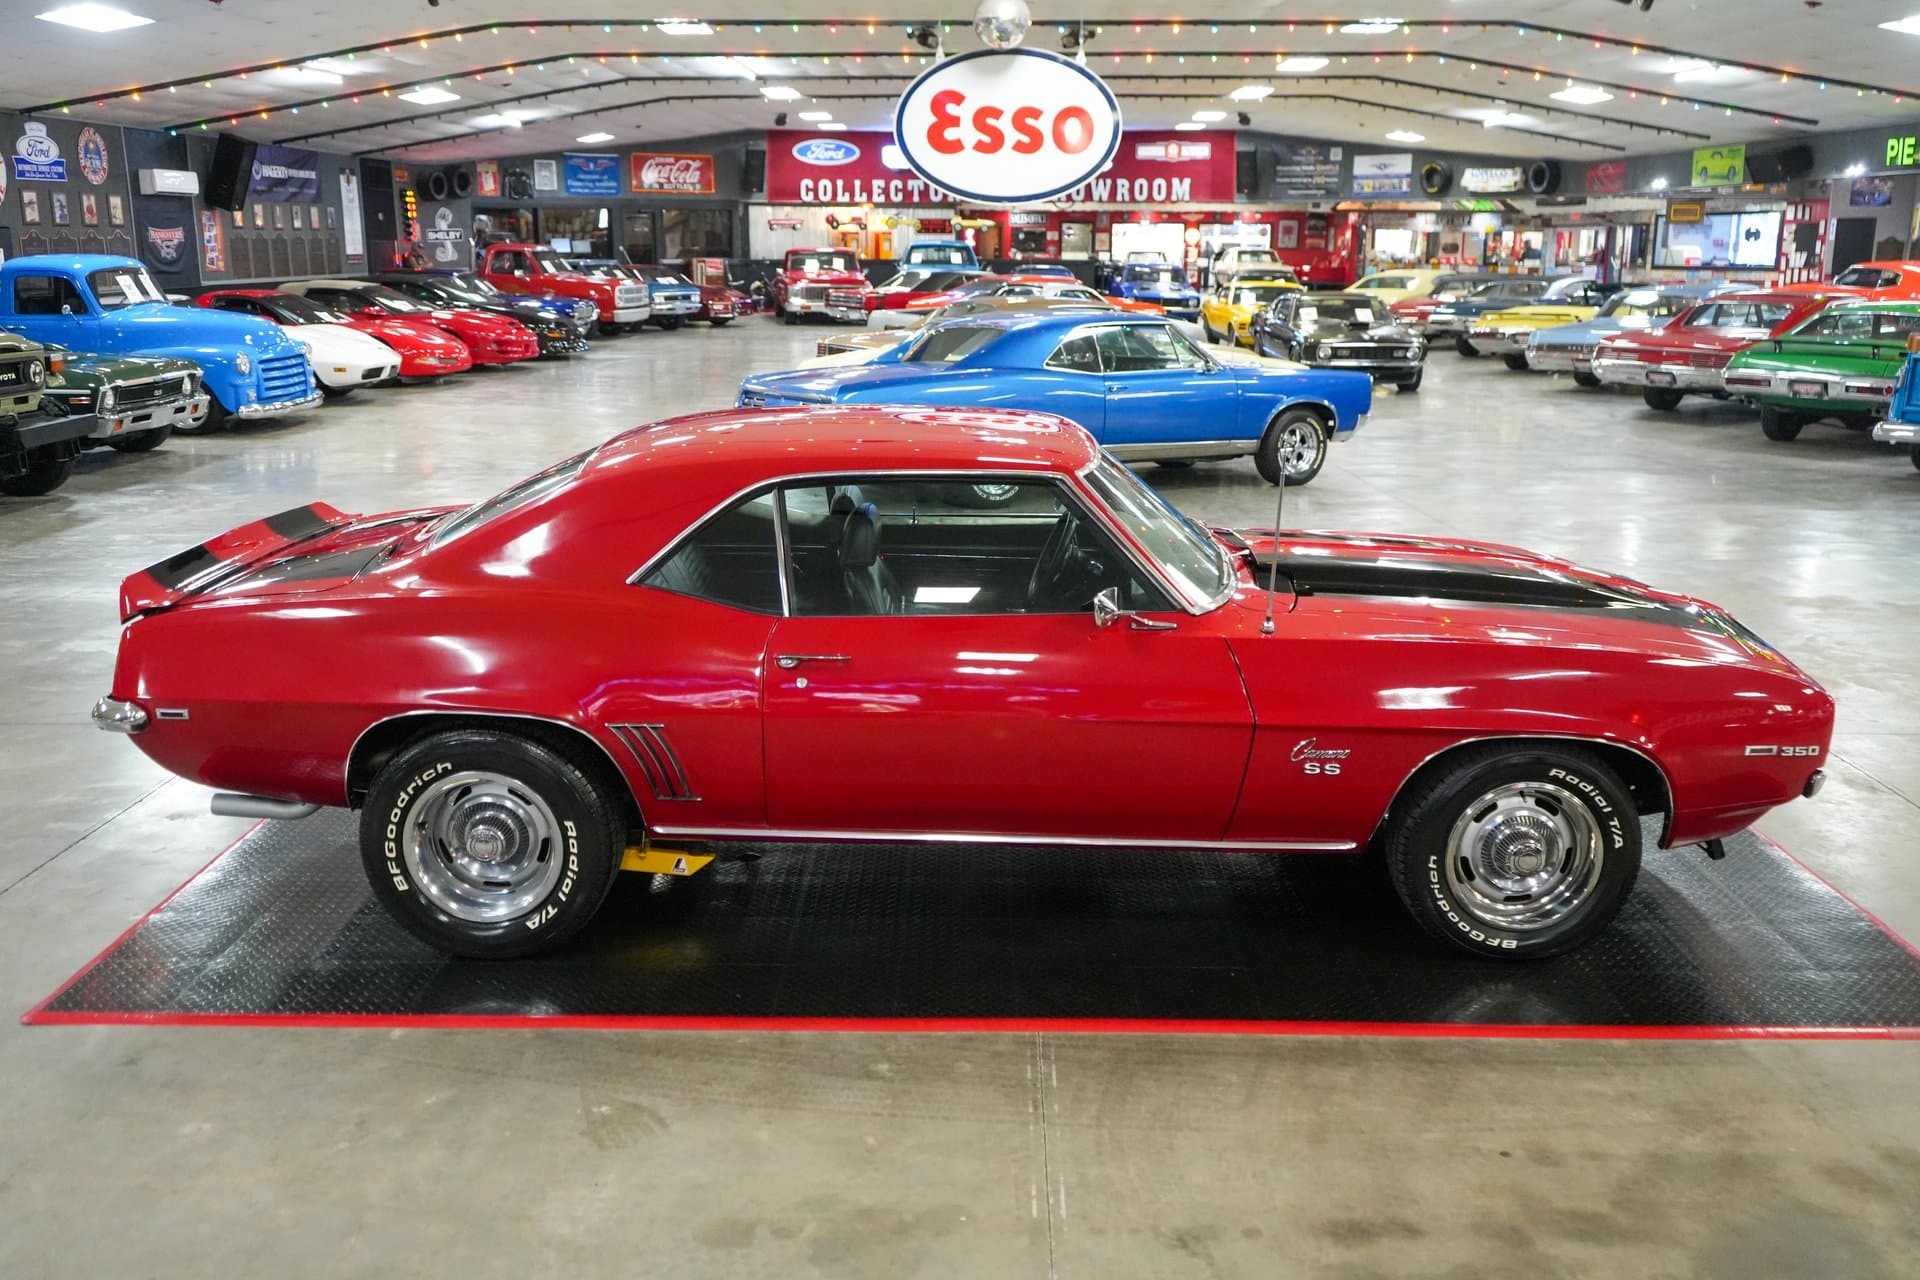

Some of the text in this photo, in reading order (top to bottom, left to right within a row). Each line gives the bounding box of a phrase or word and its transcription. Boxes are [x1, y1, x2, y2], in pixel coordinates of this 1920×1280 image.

[26, 139, 51, 158] Ford
[806, 143, 846, 160] Ford
[1886, 136, 1916, 166] PIE
[428, 231, 462, 240] SHELBY
[1291, 737, 1350, 761] Camaro
[1781, 746, 1820, 757] 350
[1304, 762, 1341, 775] SS
[1549, 768, 1624, 849] Radial T/A
[384, 762, 452, 892] BFGoodrich
[525, 820, 580, 930] Radial T/A
[1428, 855, 1519, 949] BFGoodrich
